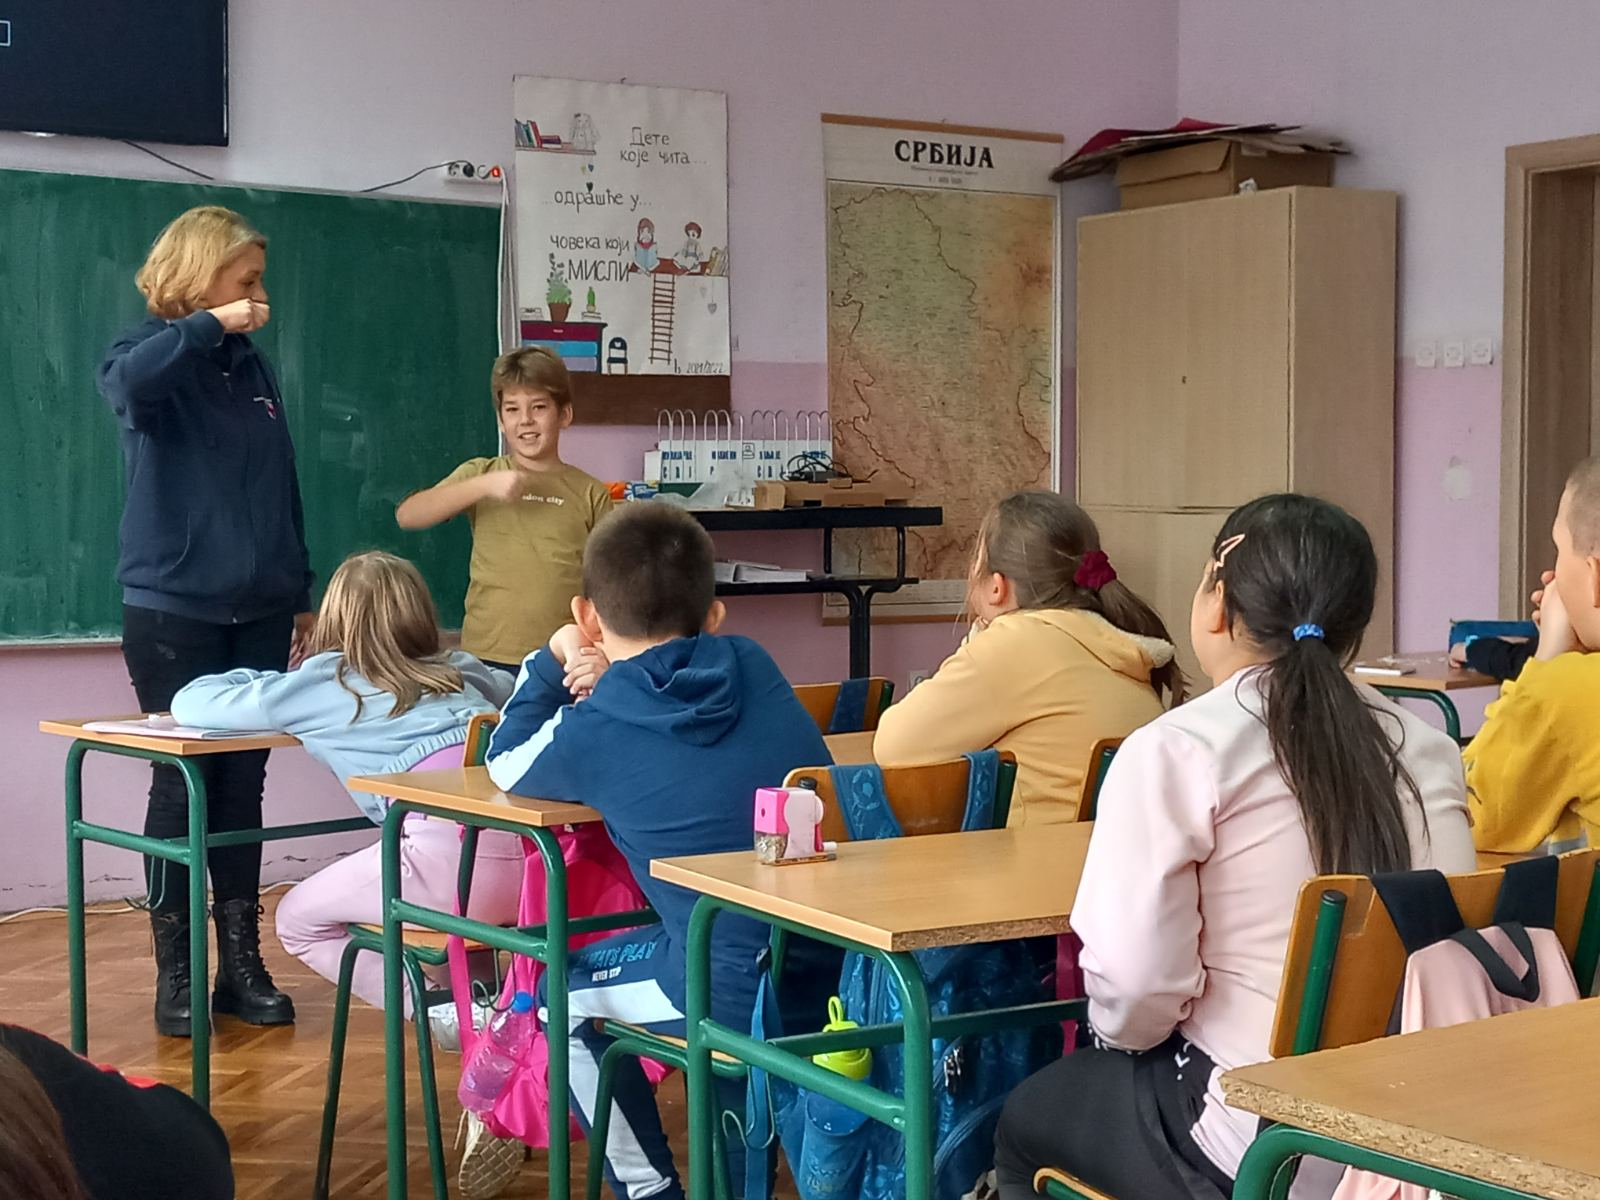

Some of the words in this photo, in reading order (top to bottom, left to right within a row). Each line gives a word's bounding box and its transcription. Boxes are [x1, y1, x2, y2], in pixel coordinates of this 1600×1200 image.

[630, 127, 670, 146] Дете
[620, 150, 649, 167] које
[894, 139, 994, 169] СРБИЈА
[550, 235, 600, 250] човека
[605, 237, 630, 256] који
[567, 258, 630, 283] МИСЛИ
[620, 941, 657, 963] PLAY
